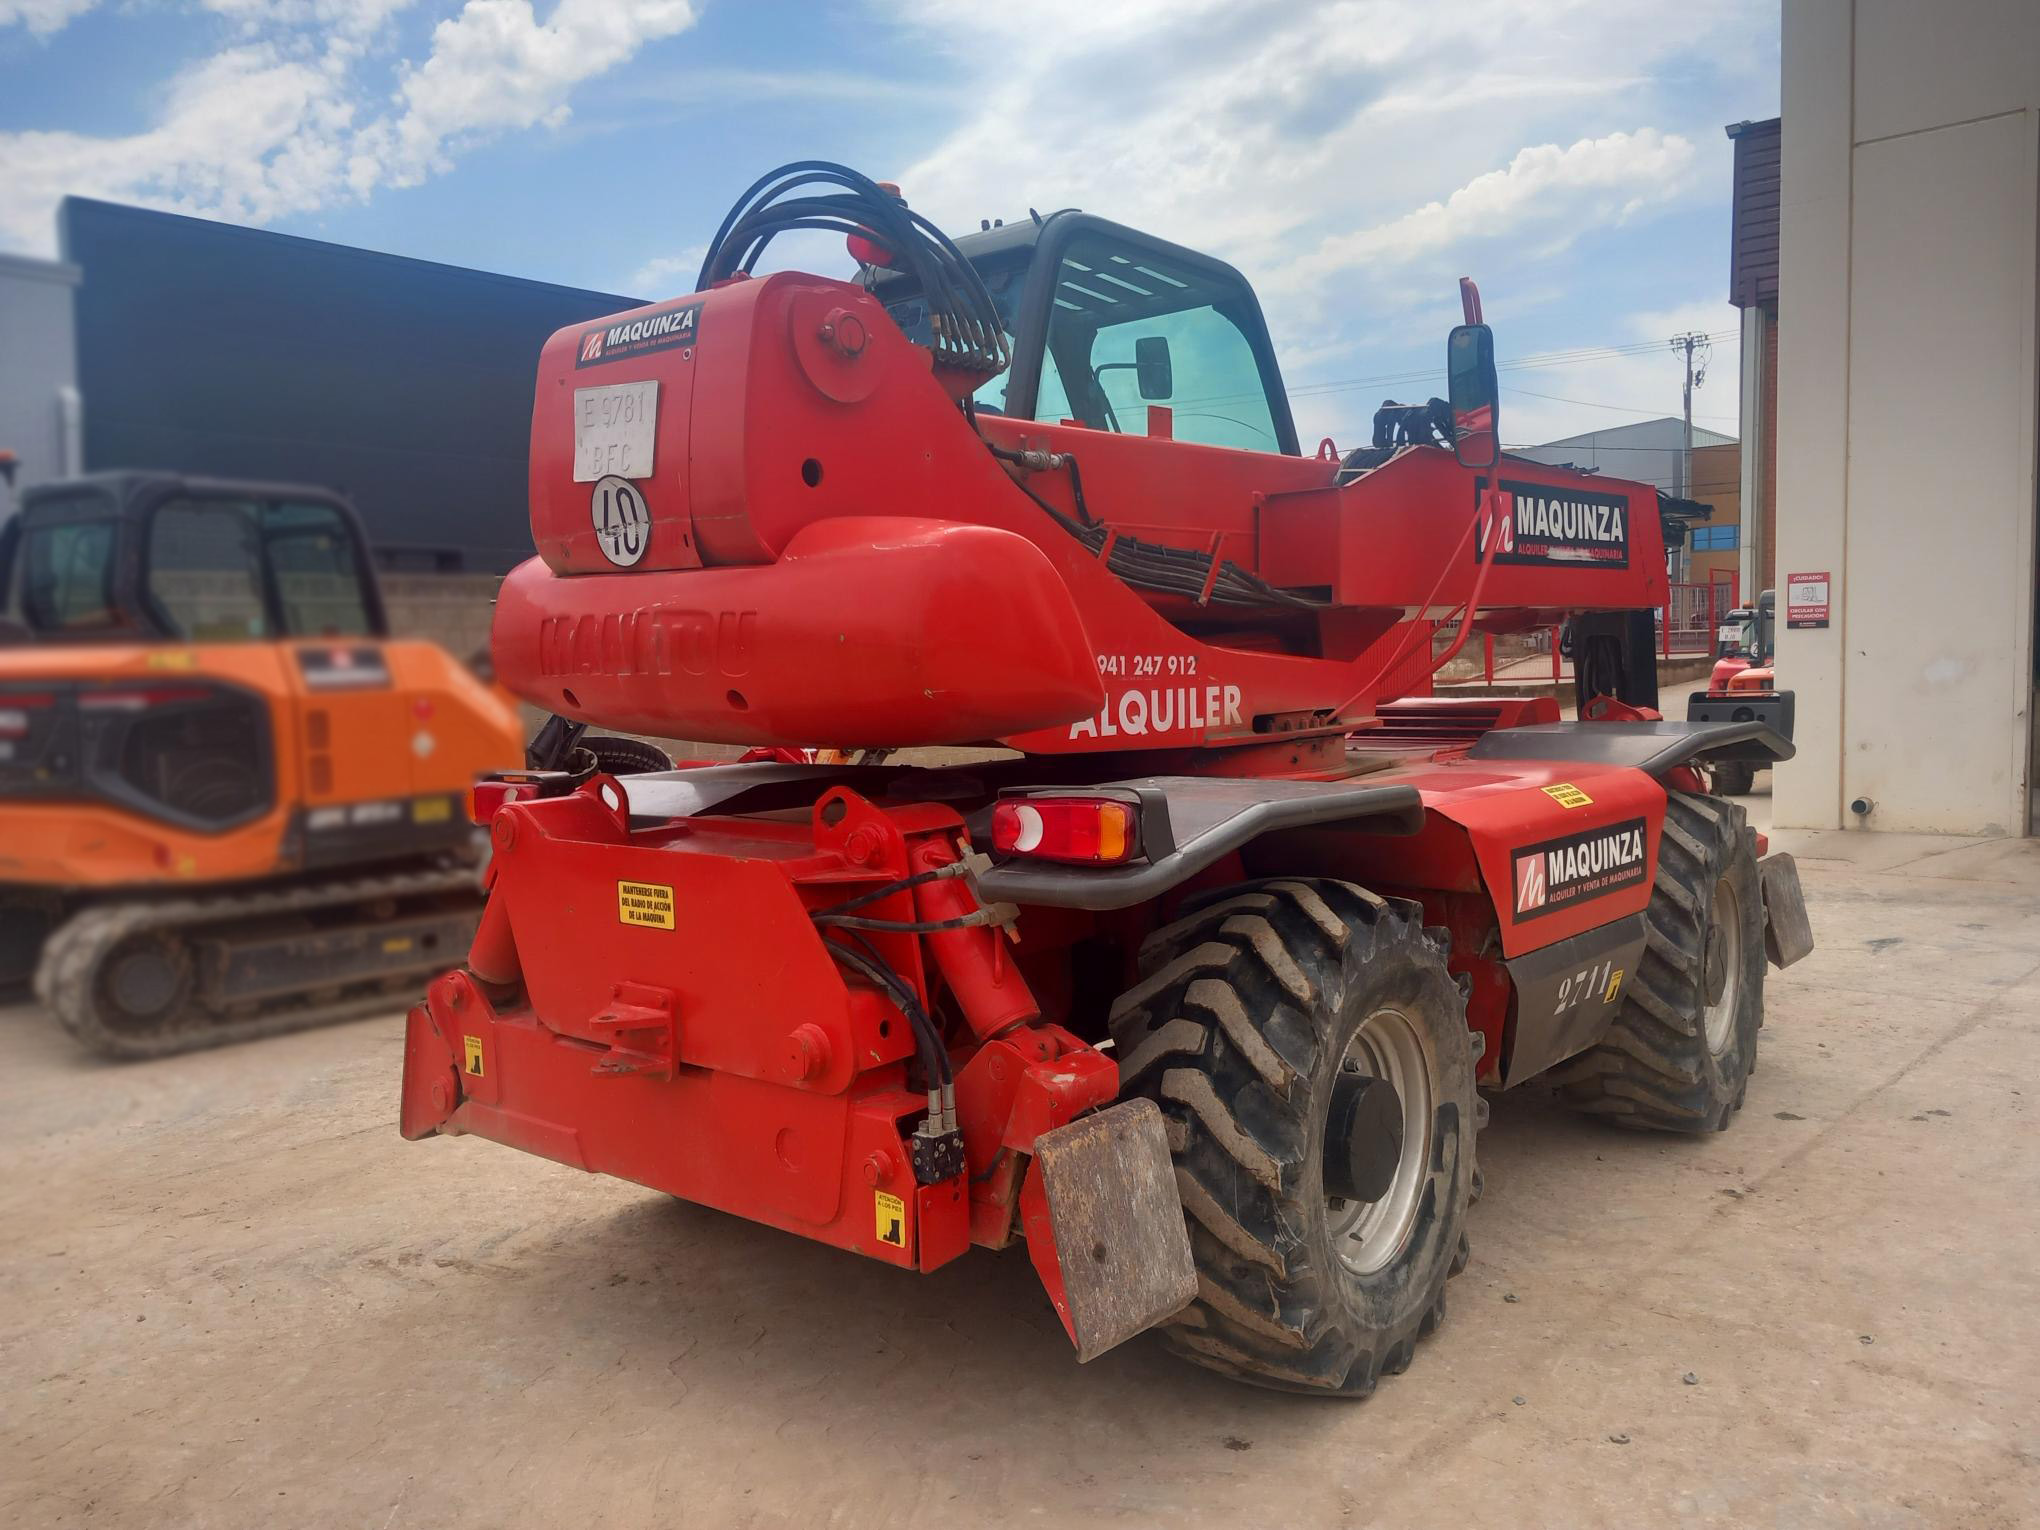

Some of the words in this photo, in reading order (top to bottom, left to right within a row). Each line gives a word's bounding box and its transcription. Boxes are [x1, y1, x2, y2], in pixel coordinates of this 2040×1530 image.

[606, 309, 694, 347] MAQUINZA
[1517, 495, 1624, 542] MAQUINZA
[1097, 655, 1126, 676] 941
[1133, 655, 1163, 676] 247
[1168, 655, 1197, 676] 912
[1548, 829, 1643, 886] MAQUINZA
[1549, 886, 1576, 903] ALQUILER
[1577, 884, 1582, 894] Y
[1583, 880, 1600, 892] VENTA
[1601, 876, 1609, 887] DE
[1609, 866, 1642, 884] MAQUINARIA
[621, 897, 631, 907] DEL
[647, 899, 653, 910] DE
[628, 910, 635, 920] DE
[636, 911, 642, 920] LA
[1553, 960, 1612, 1016] 2711
